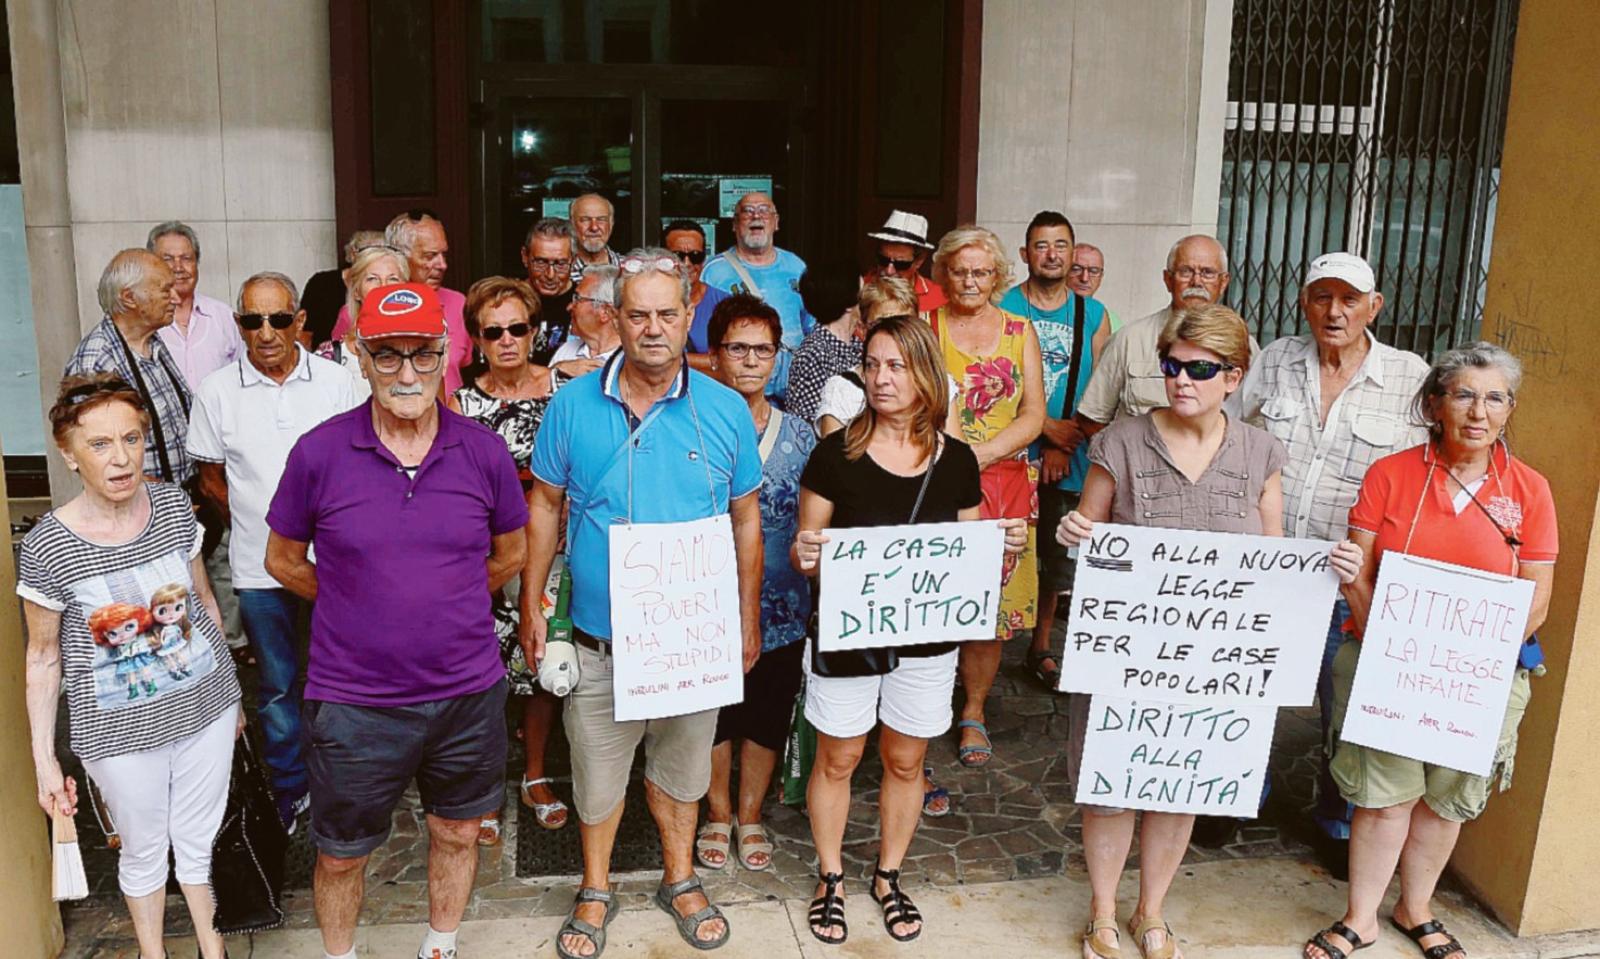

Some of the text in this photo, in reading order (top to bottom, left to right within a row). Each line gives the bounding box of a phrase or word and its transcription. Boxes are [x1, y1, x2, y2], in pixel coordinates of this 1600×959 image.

[620, 533, 730, 590] SIAMO
[832, 537, 966, 560] LA CASA
[1088, 532, 1331, 573] NO ALLA NUOVA
[912, 570, 950, 594] UN
[1157, 573, 1255, 600] LEGGE
[632, 588, 719, 626] POVERI
[1079, 597, 1271, 632] REGIONALE
[1380, 582, 1515, 643] RITIRATE
[626, 618, 726, 653] MA NON
[1073, 632, 1280, 665] PER LE CASE
[643, 645, 731, 674] STUPIDI
[1385, 637, 1504, 681] LA LEGGE
[1123, 668, 1273, 698] POPOLARI!
[1130, 743, 1203, 771] ALLA
